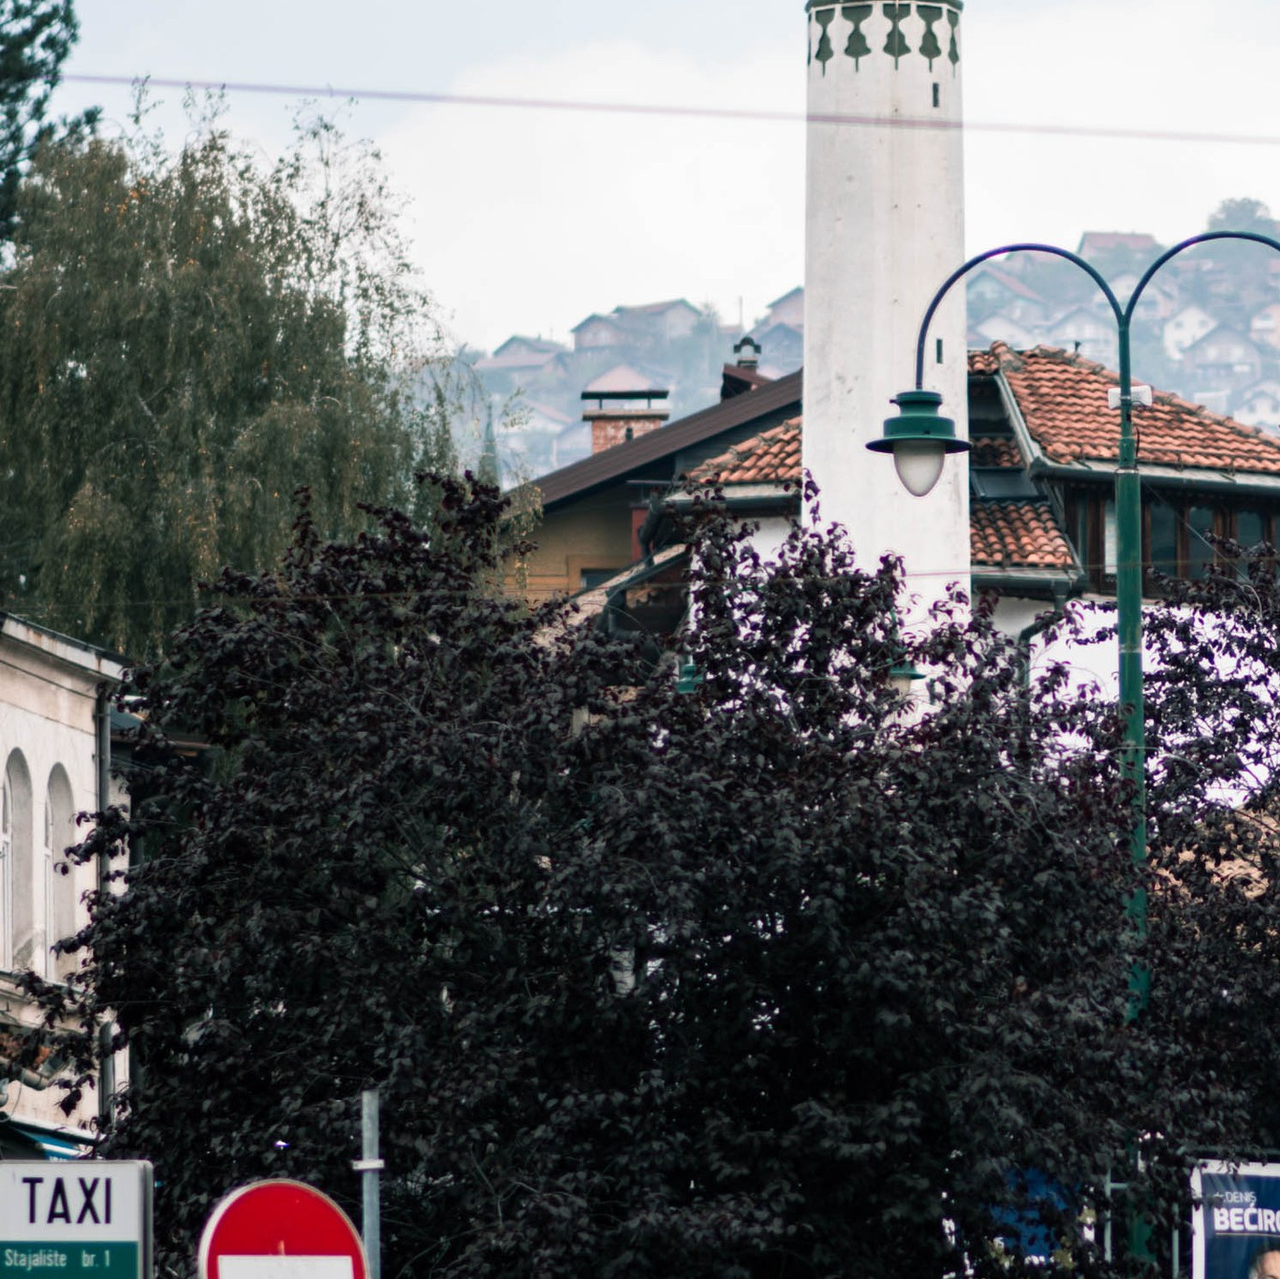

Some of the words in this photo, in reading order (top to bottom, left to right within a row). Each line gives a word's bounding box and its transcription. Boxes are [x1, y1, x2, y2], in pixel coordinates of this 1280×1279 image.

[22, 1177, 112, 1224] TAXI
[4, 1248, 68, 1271] Stajalište
[104, 1250, 111, 1267] 1
